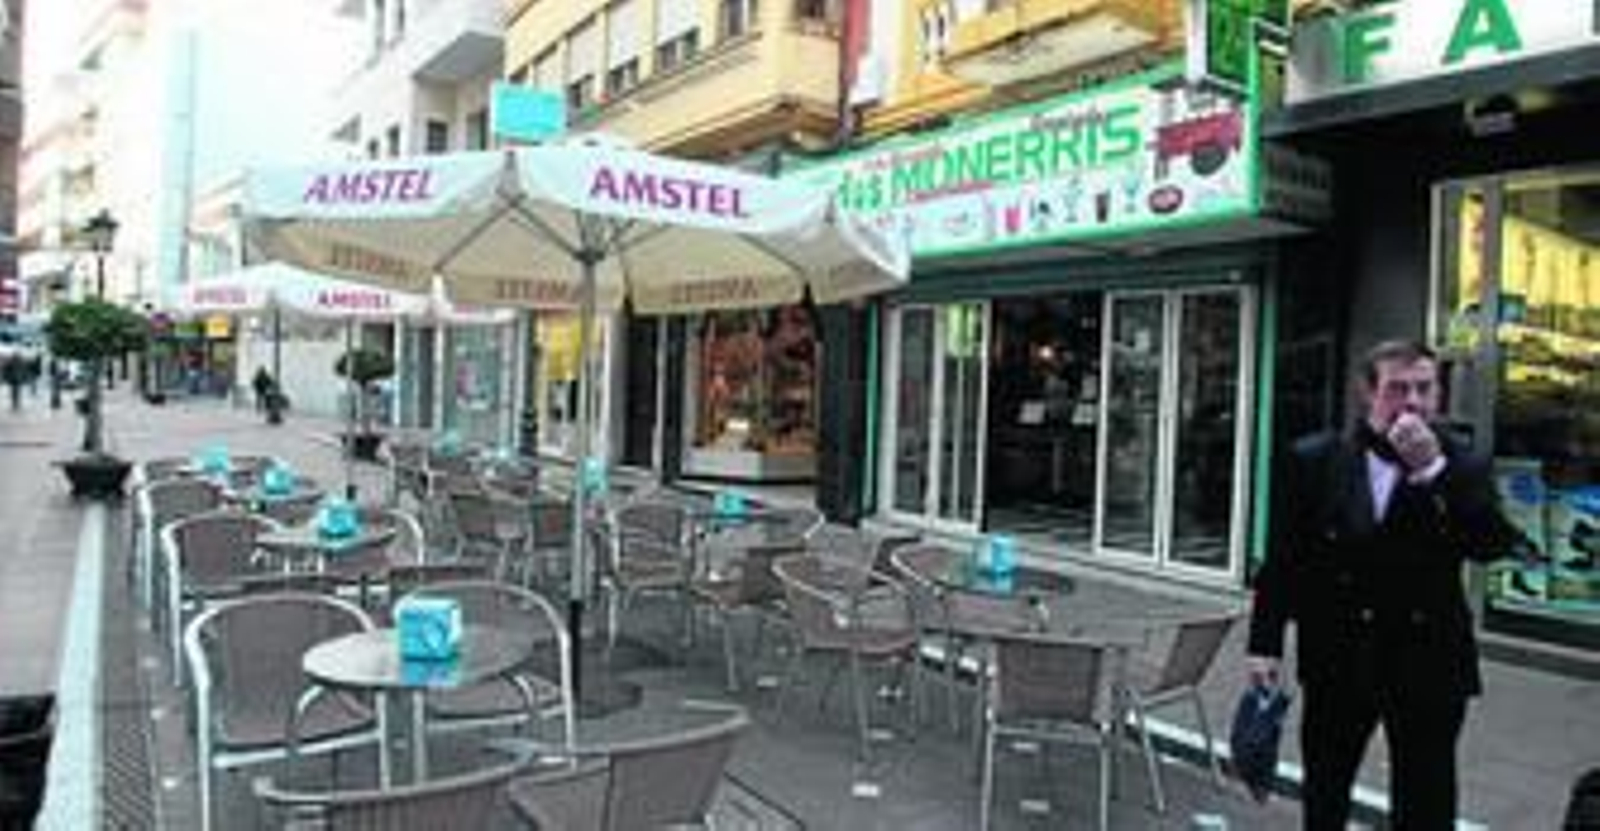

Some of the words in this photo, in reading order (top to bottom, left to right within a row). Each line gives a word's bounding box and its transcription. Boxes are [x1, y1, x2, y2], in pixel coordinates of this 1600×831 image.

[891, 103, 1140, 208] MONERRIS
[303, 168, 437, 204] AMSTEL
[590, 165, 750, 217] AMSTEL
